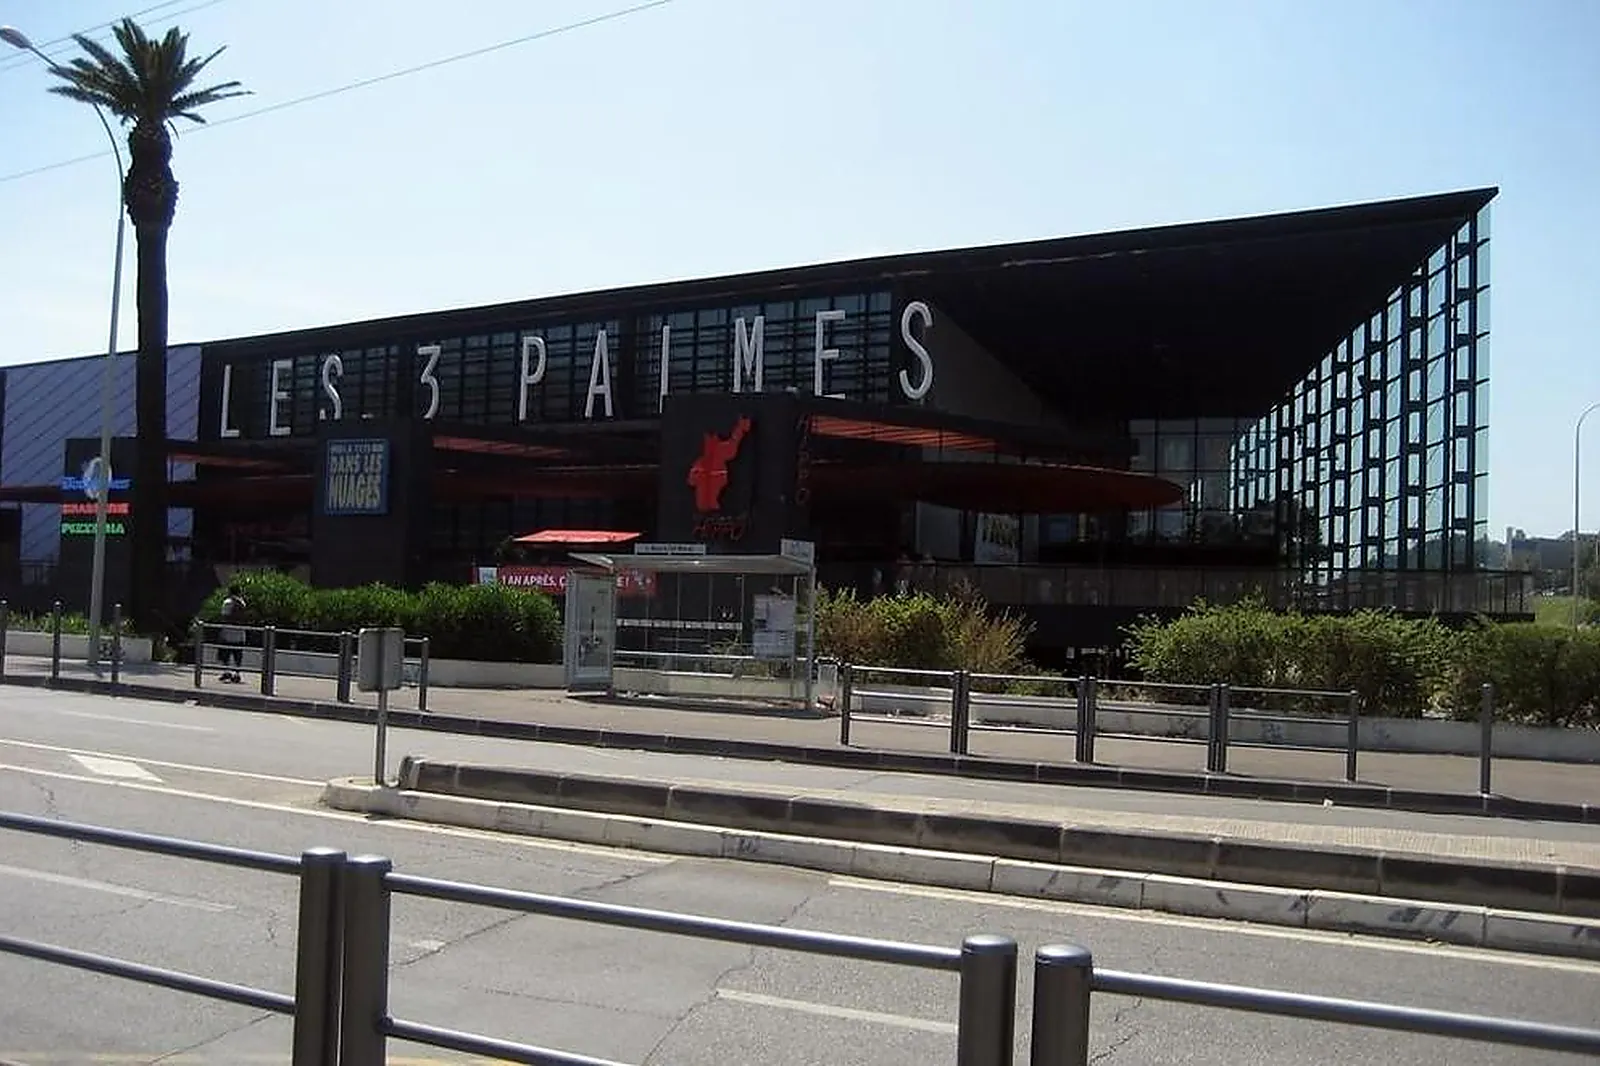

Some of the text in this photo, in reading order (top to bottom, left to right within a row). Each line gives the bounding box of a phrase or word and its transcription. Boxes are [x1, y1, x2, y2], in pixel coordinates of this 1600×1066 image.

[220, 354, 343, 438] LES
[417, 345, 441, 420] 3
[328, 474, 381, 509] NUAGES
[507, 575, 522, 586] AN
